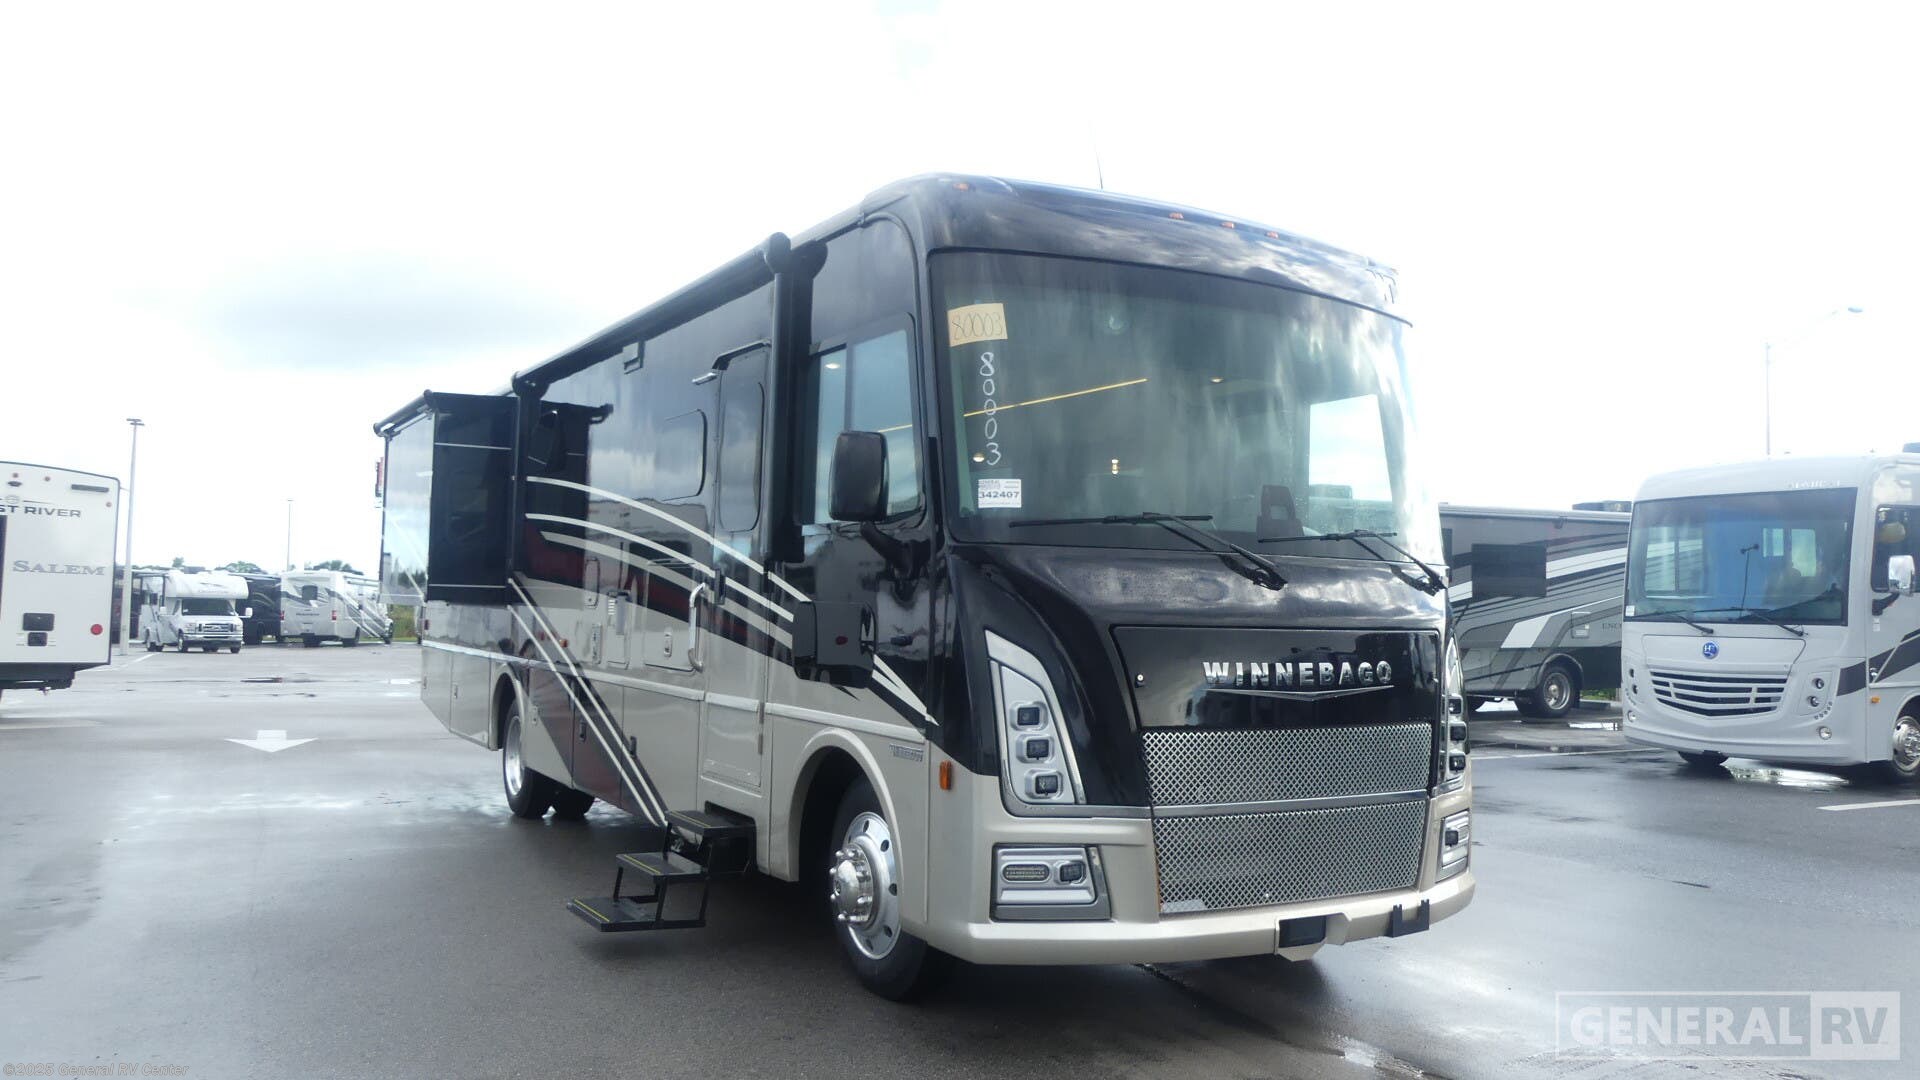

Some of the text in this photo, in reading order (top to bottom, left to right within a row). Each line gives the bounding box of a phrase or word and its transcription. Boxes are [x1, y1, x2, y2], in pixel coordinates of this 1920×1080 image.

[951, 312, 1003, 340] 80003
[979, 351, 1002, 466] 80003
[979, 490, 1020, 499] 342407
[24, 506, 81, 518] RIVER
[12, 560, 106, 576] SALEM
[1202, 660, 1392, 686] WINNEBAGO
